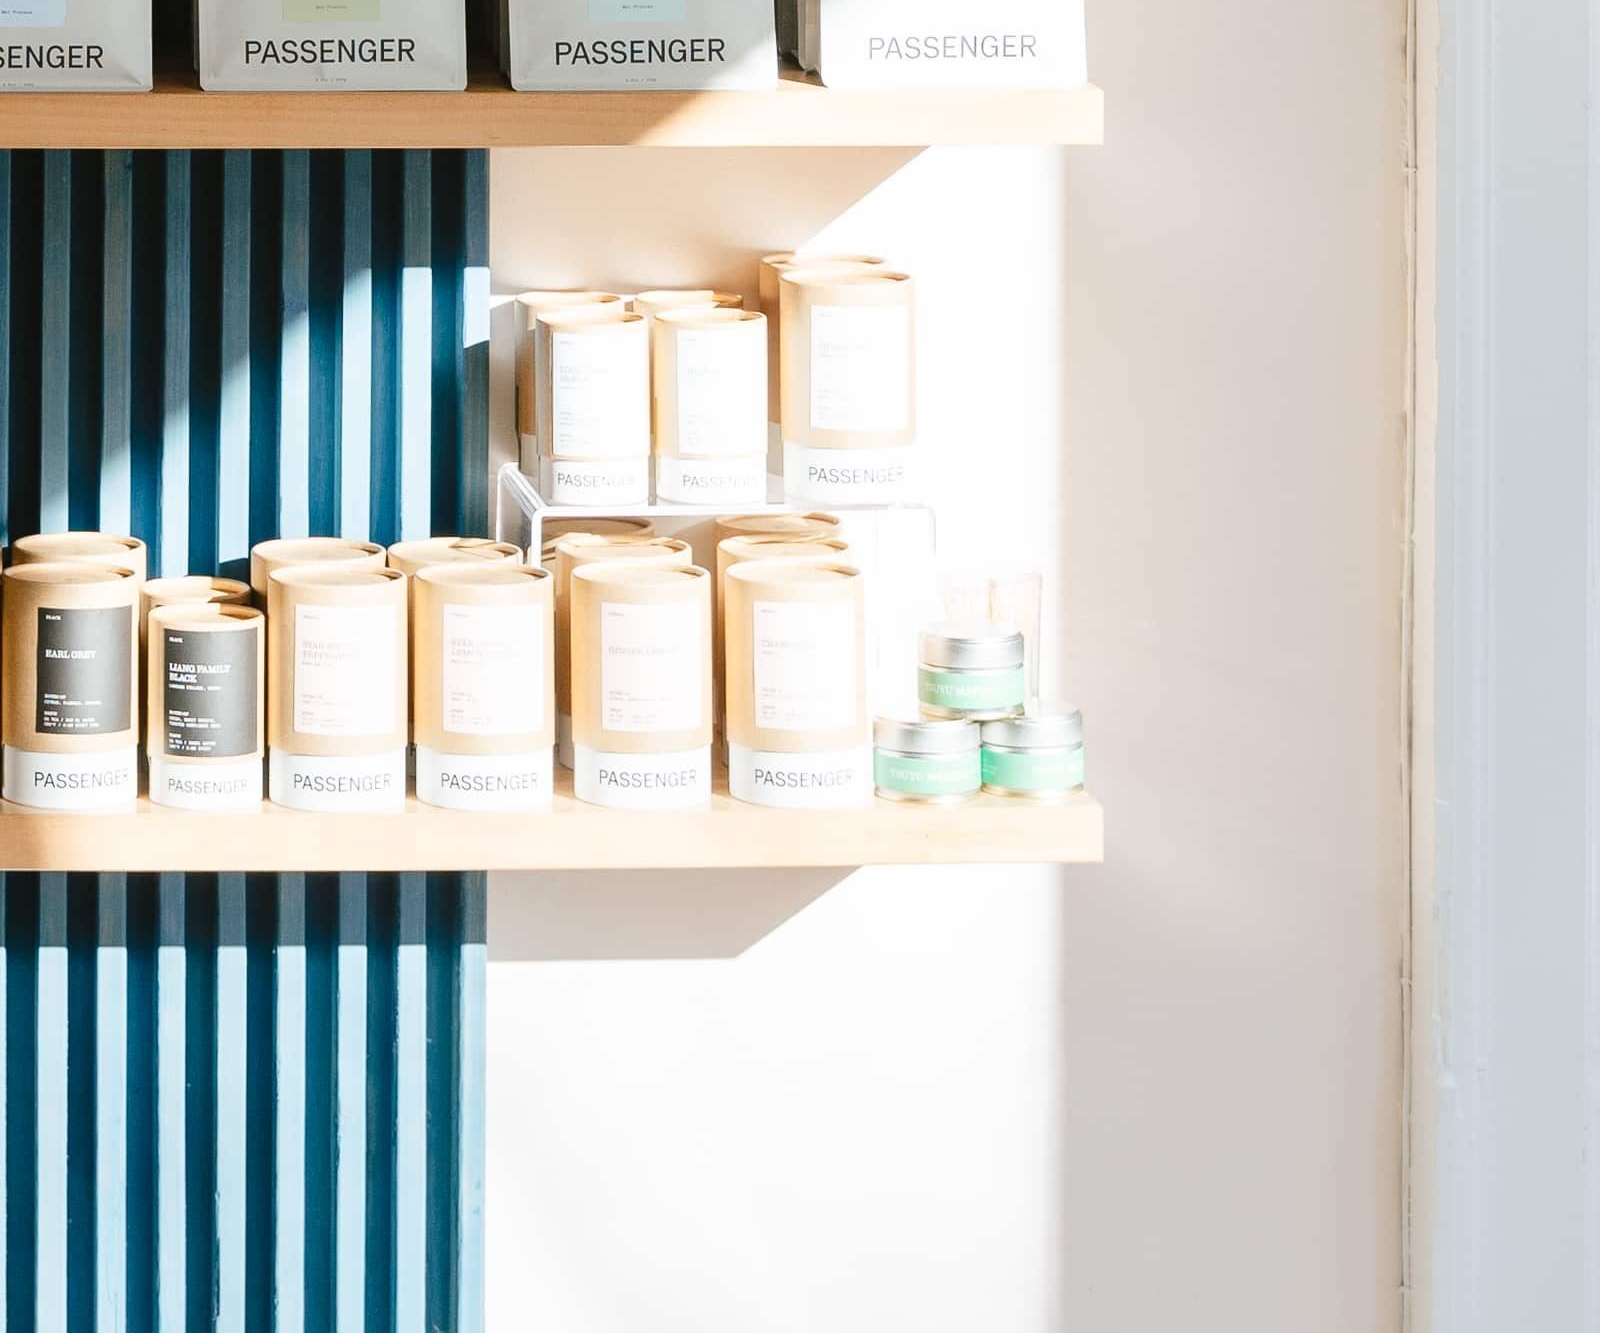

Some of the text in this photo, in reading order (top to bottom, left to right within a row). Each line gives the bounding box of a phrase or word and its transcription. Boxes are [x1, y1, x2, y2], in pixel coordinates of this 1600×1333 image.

[246, 39, 414, 63] PASSENGER
[556, 39, 724, 65] PASSENGER
[870, 35, 1036, 59] PASSENGER
[45, 649, 97, 659] EARL GREY
[169, 663, 231, 674] LIANG FAMILY
[169, 673, 197, 683] BLACK
[34, 768, 129, 789] PASSENGER
[168, 778, 248, 794] PASSENGER
[293, 772, 392, 792] PASSENGER
[440, 772, 539, 792] PASSENGER
[599, 768, 697, 789] PASSENGER
[754, 768, 854, 789] PASSENGER
